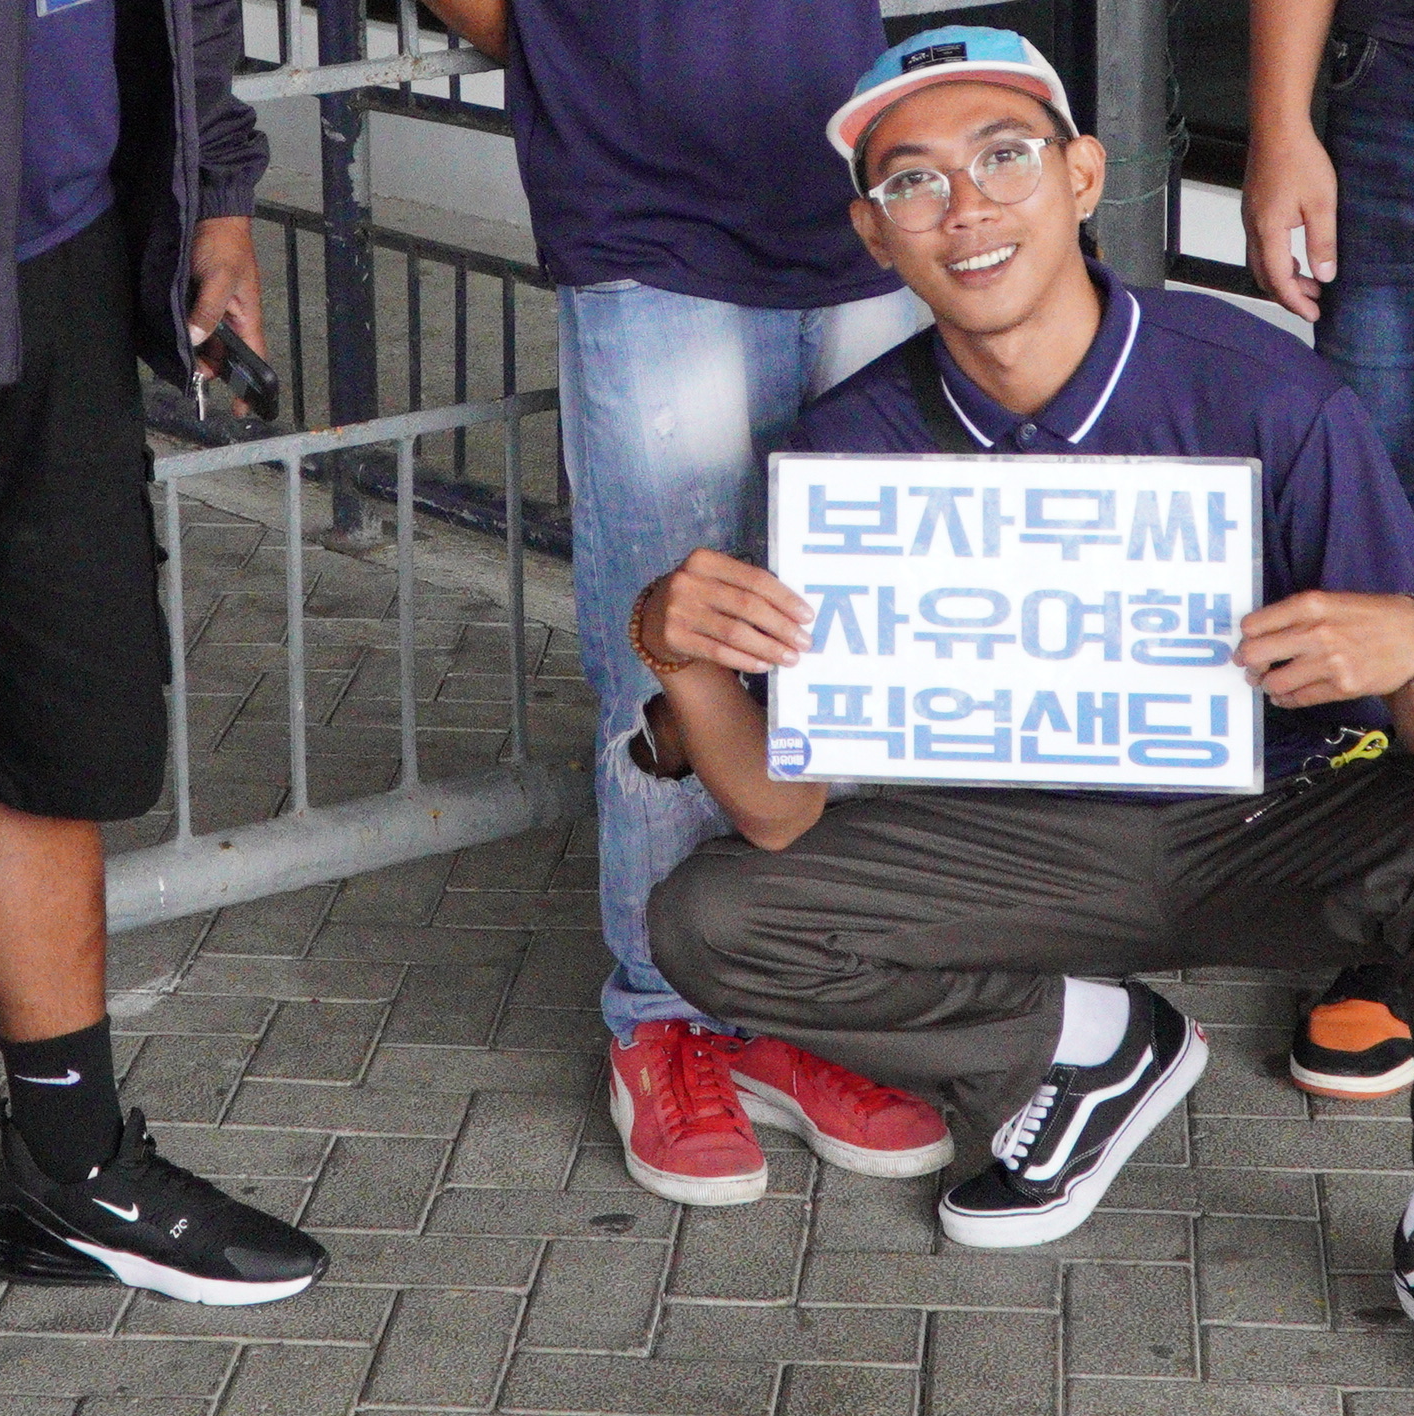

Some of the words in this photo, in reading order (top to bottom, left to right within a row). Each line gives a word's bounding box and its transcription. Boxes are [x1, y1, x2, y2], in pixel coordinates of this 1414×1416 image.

[802, 484, 1238, 563] 보자무싸
[804, 584, 1233, 667] 자유여행
[808, 684, 1230, 768] 픽업샌딩
